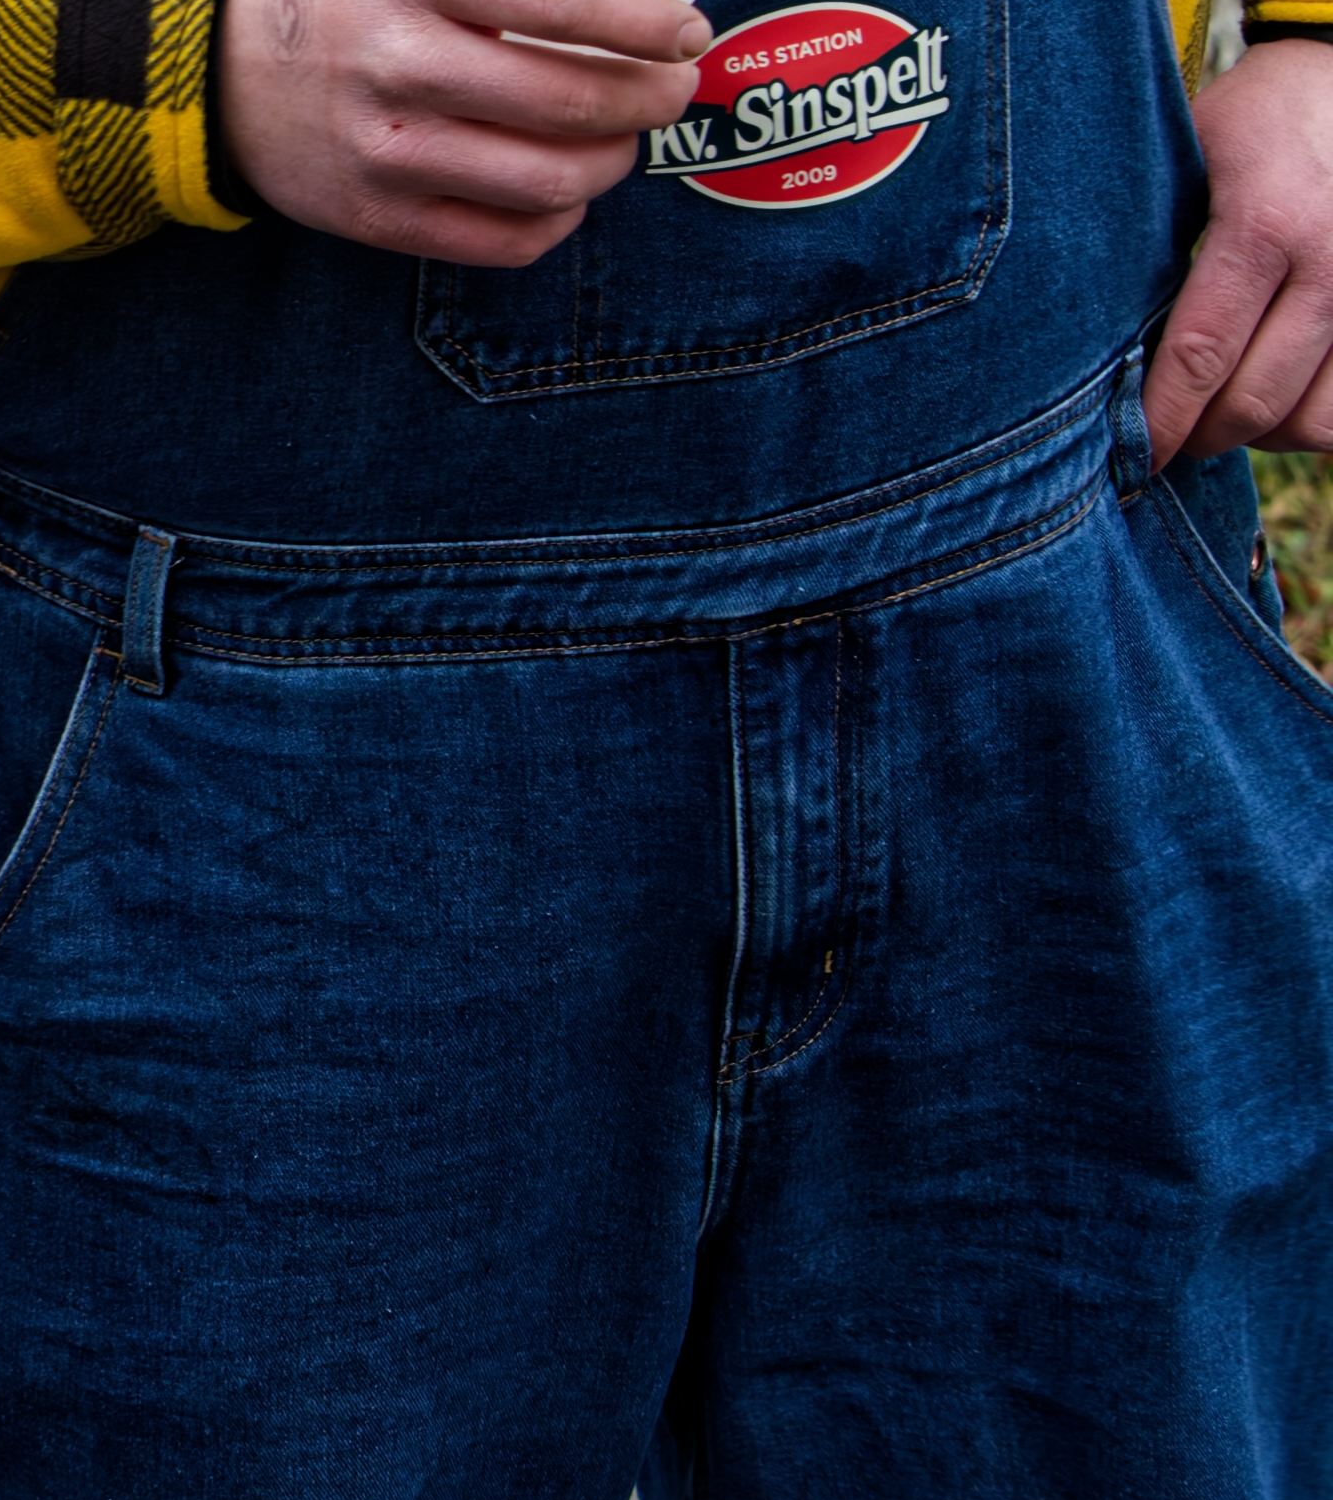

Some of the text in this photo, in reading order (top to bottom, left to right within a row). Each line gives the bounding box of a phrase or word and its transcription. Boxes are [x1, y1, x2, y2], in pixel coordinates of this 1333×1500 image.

[724, 28, 863, 74] GAS STATION
[735, 26, 949, 151] Sinspelt
[781, 164, 837, 189] 2009
